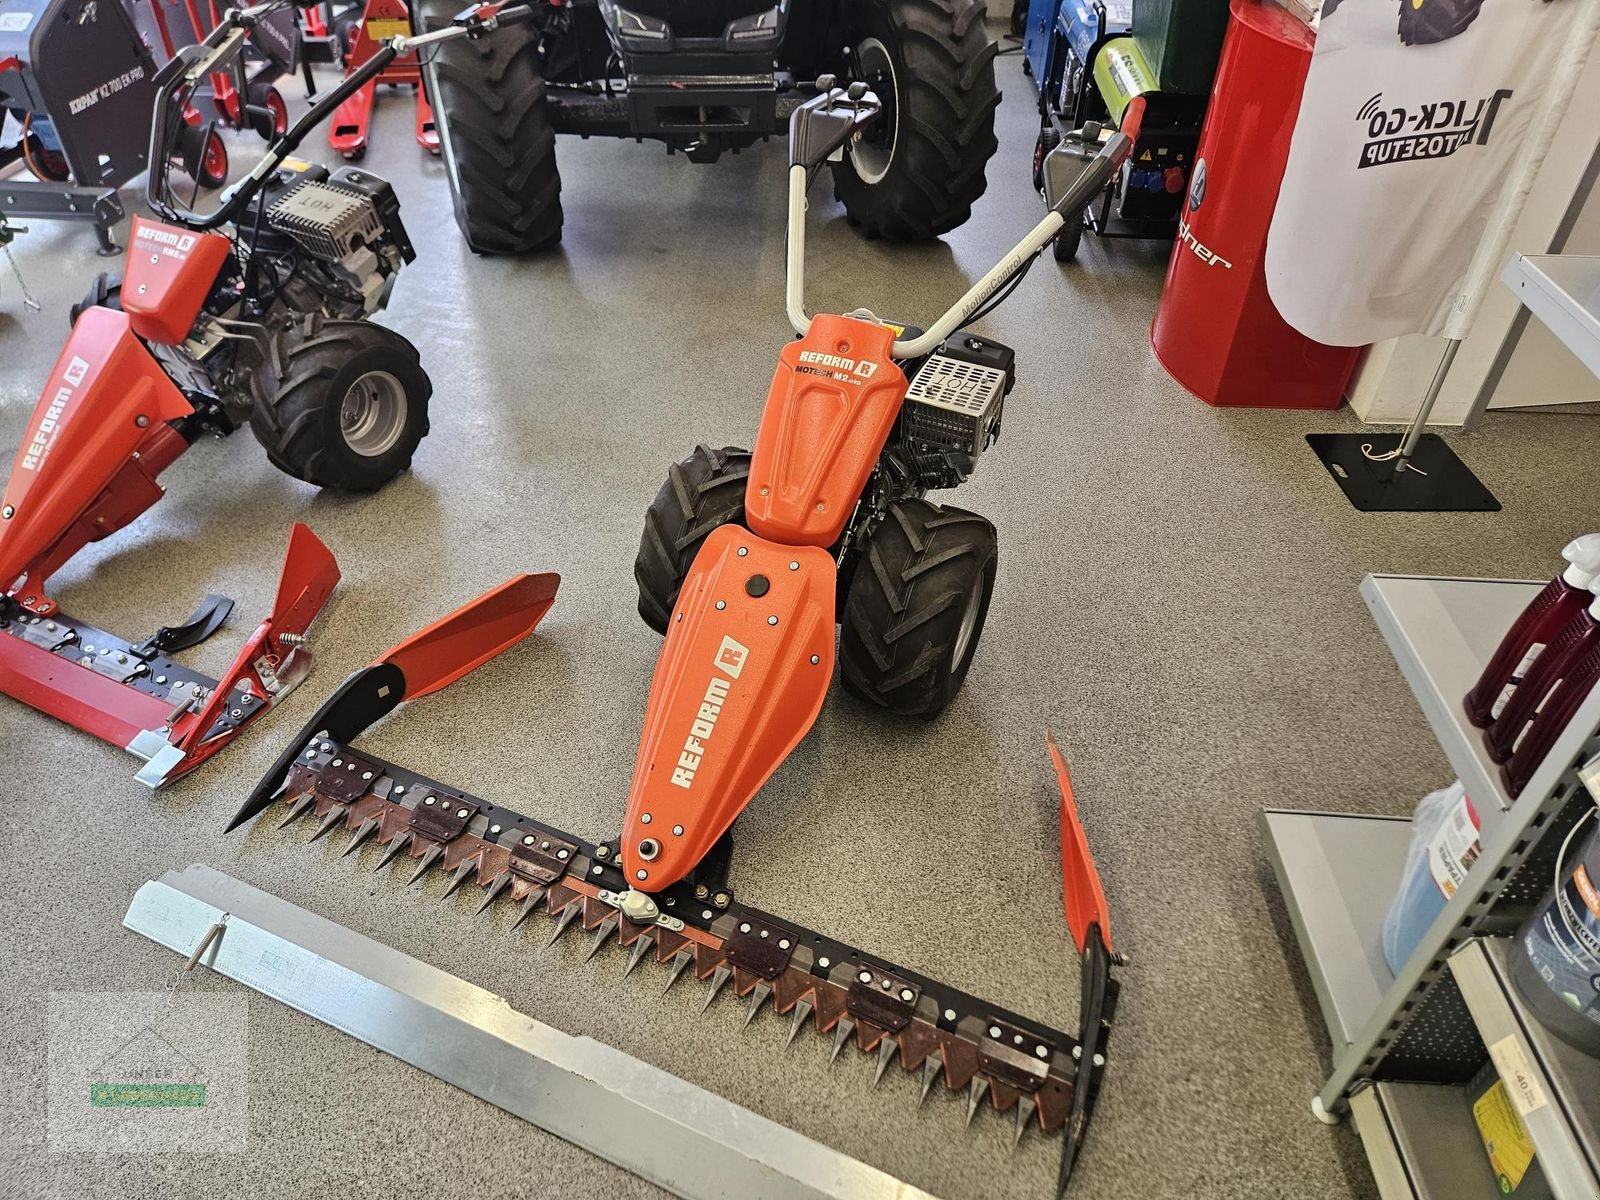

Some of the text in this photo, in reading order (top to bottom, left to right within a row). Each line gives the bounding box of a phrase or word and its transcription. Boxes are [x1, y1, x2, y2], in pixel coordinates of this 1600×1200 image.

[130, 65, 145, 83] PRO
[298, 197, 335, 212] HOT
[137, 226, 179, 246] REFORM
[1179, 213, 1232, 269] dner
[961, 256, 1022, 318] MotionControl
[799, 351, 855, 371] REFORM
[933, 375, 978, 393] HOT
[22, 387, 73, 471] REFORM
[671, 677, 731, 789] REFORM
